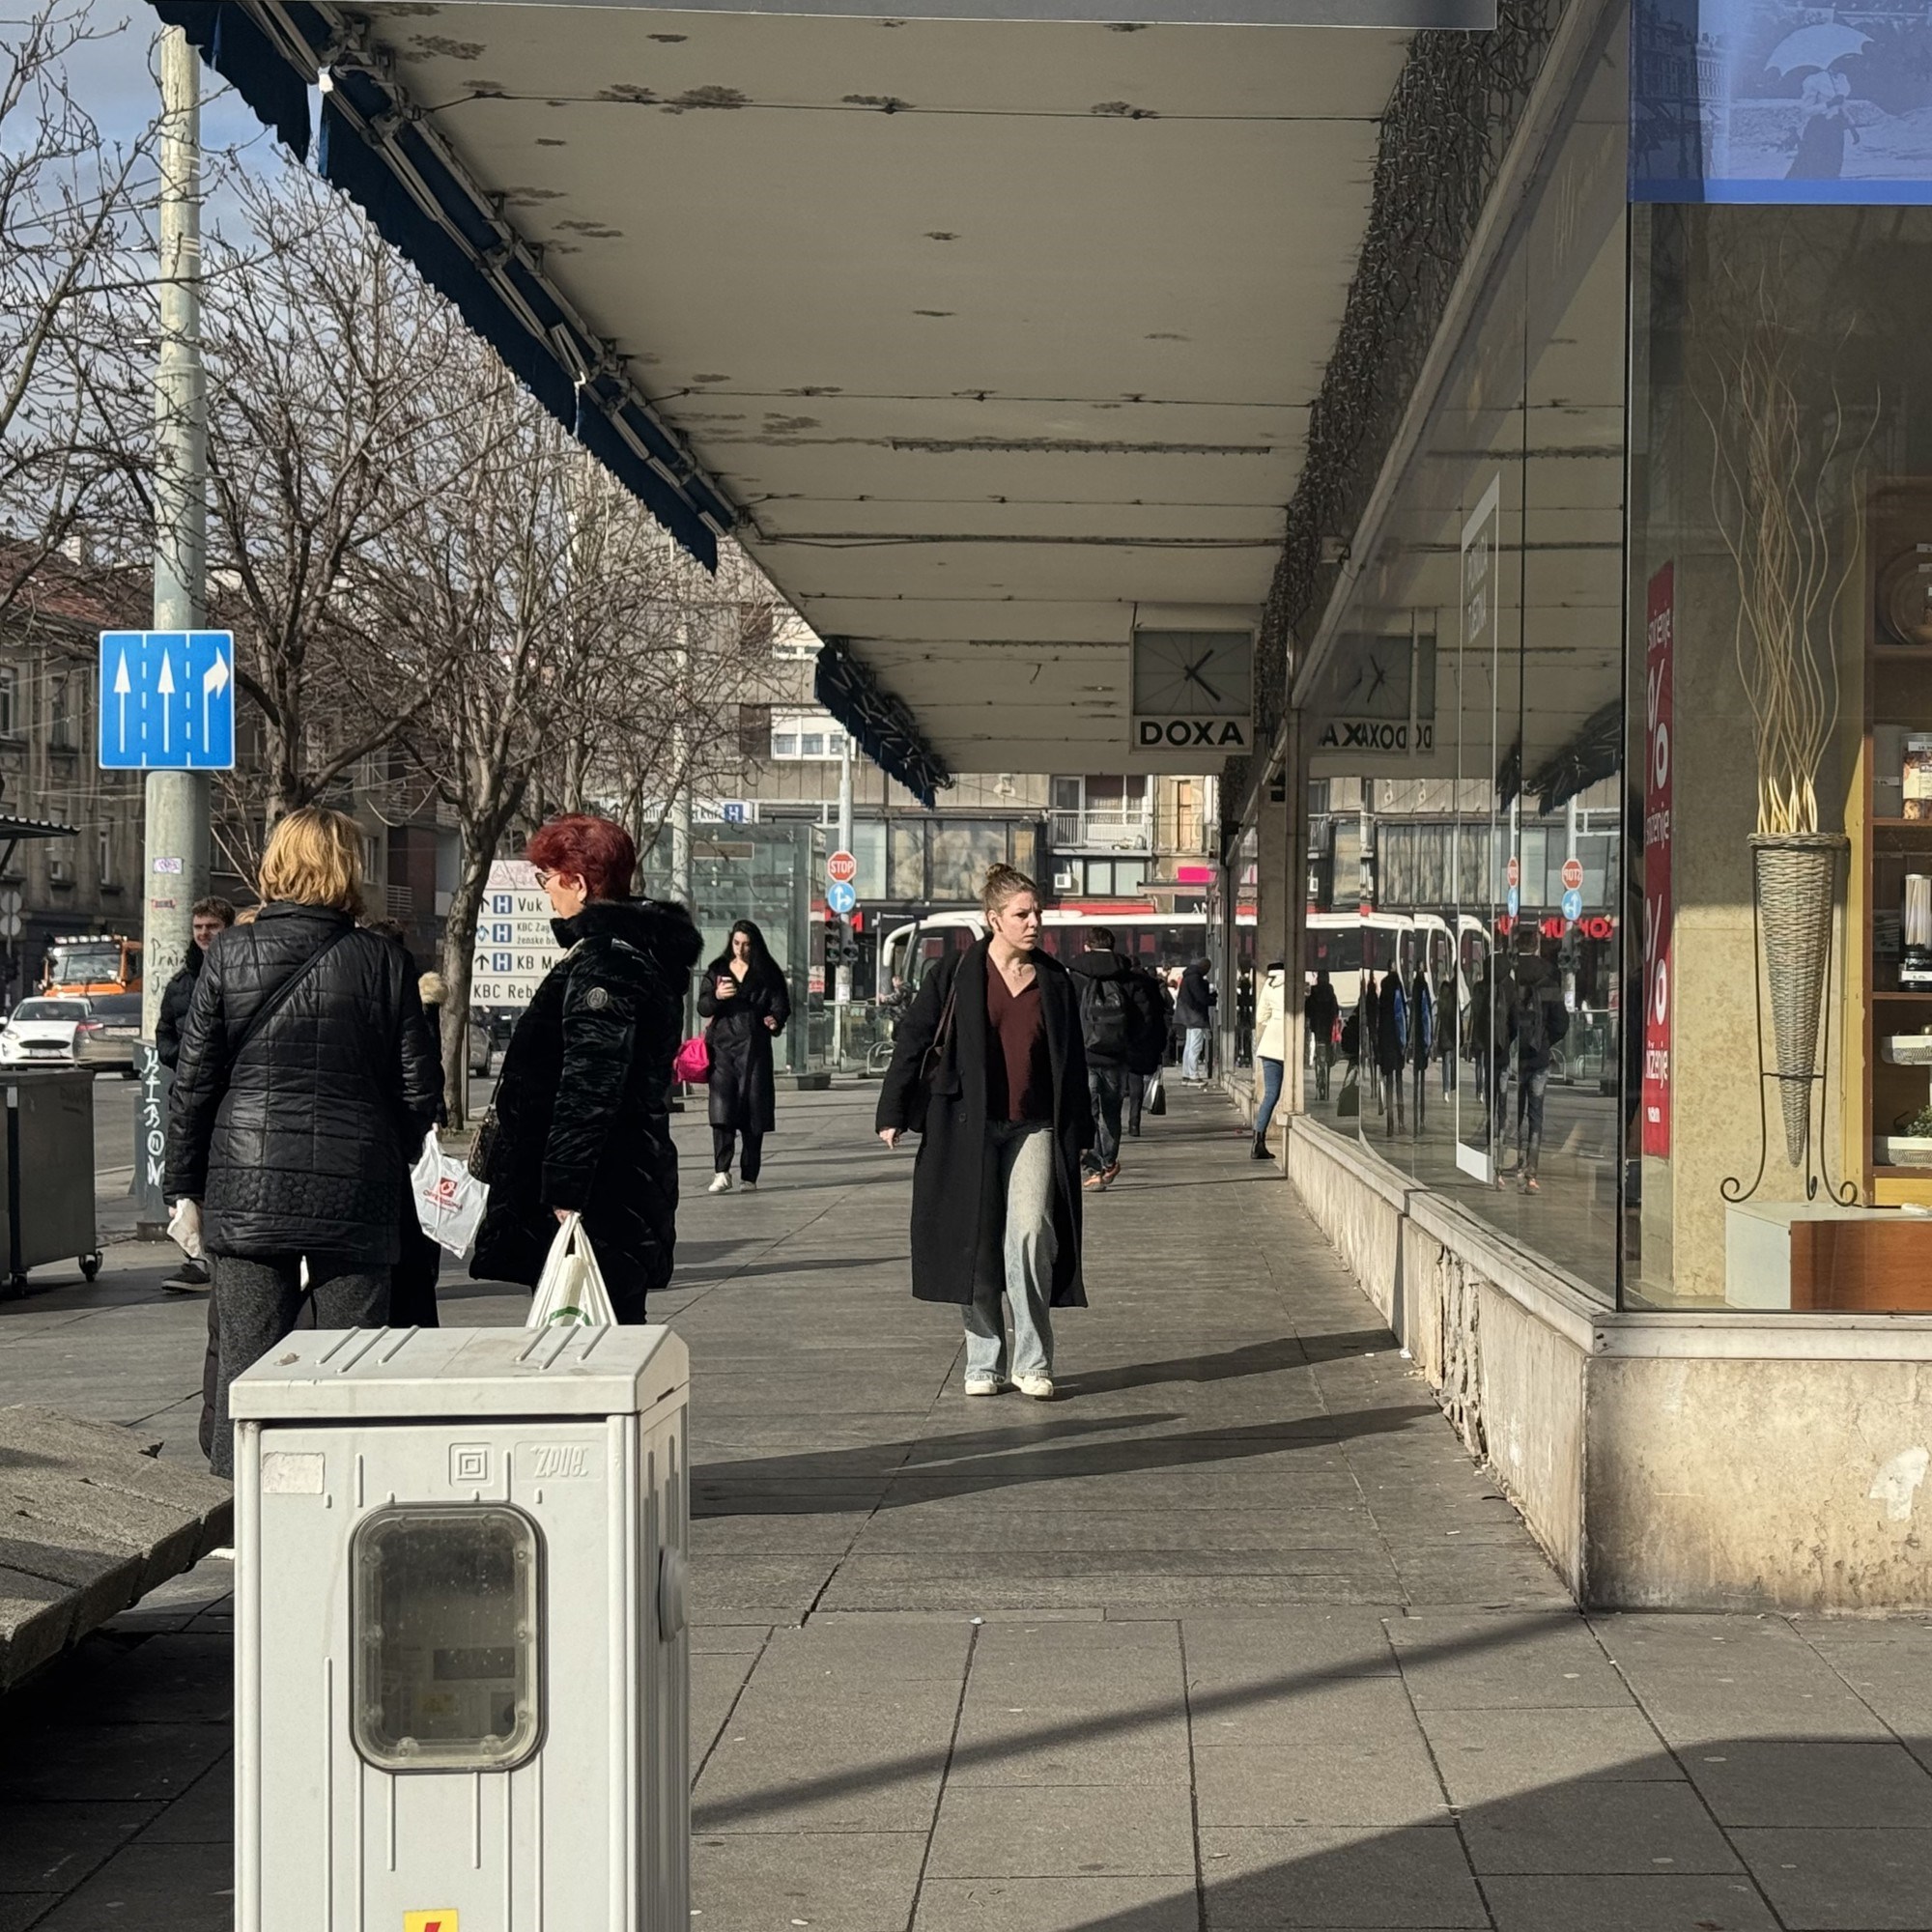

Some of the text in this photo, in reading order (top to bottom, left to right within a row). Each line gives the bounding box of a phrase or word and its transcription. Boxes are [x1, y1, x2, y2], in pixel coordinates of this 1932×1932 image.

[1141, 720, 1244, 746] DOXA
[830, 862, 854, 873] STOP
[518, 897, 543, 911] Vuk
[517, 923, 532, 932] KBC
[517, 933, 544, 945] ženske
[517, 956, 534, 969] KB
[473, 984, 536, 998] KBC Reb
